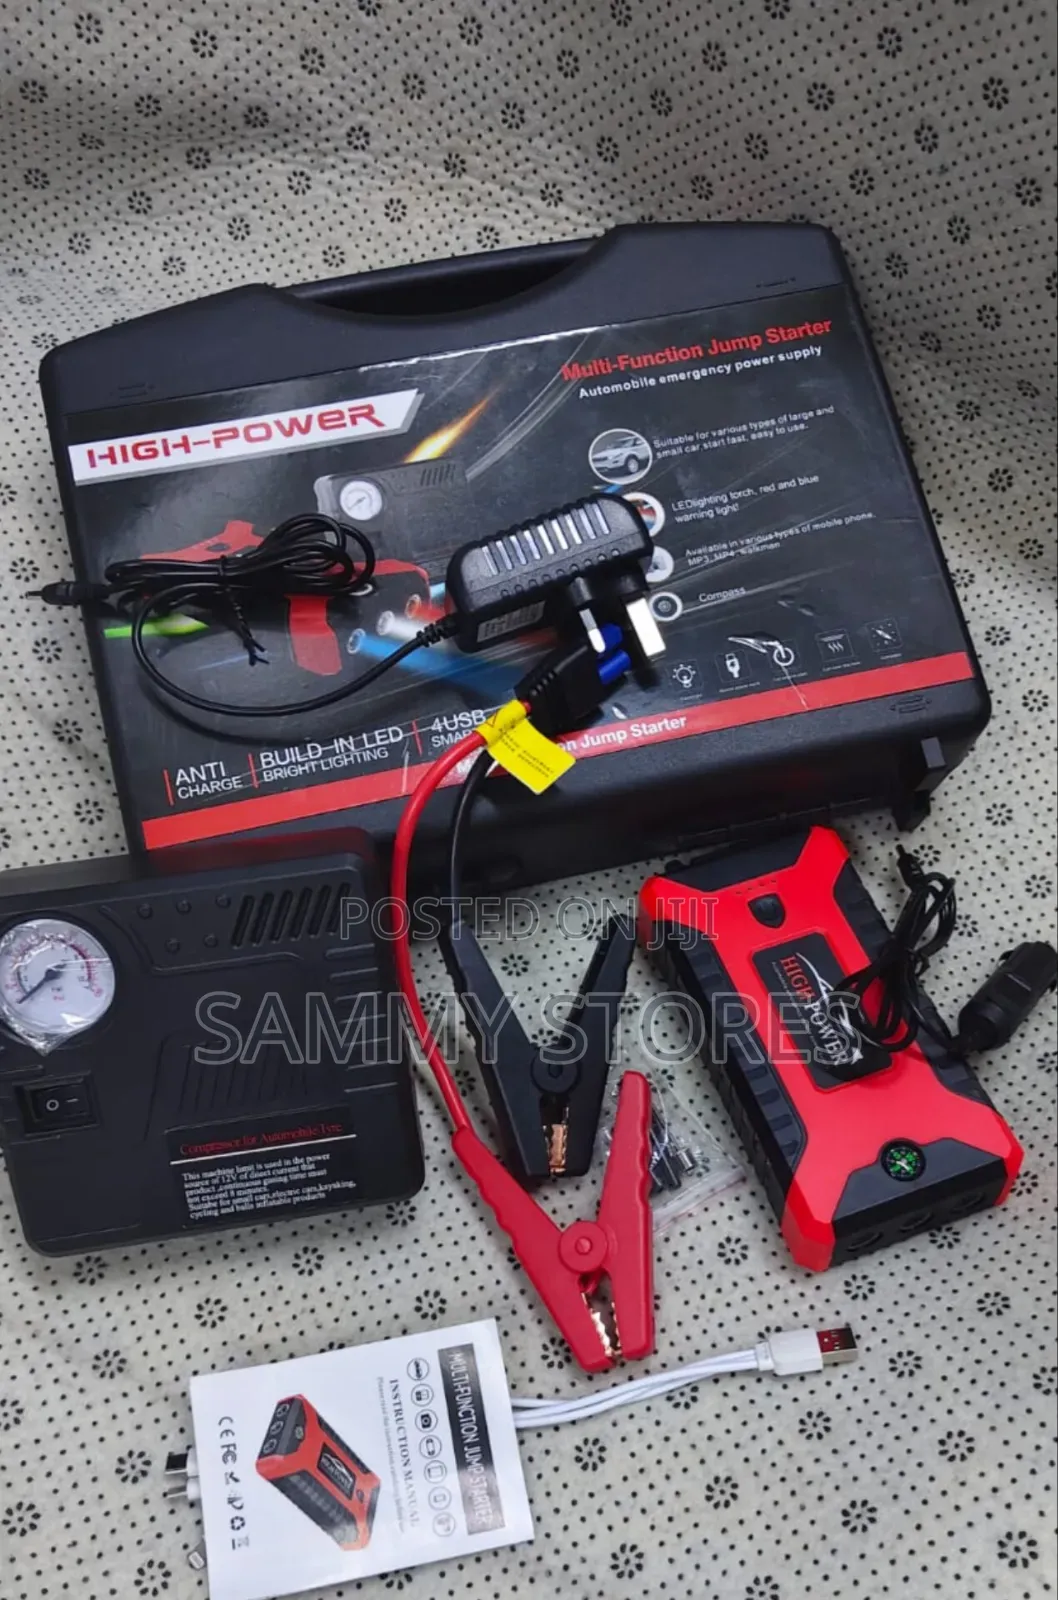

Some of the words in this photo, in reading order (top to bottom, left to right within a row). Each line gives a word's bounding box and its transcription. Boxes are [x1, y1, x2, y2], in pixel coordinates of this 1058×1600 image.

[561, 343, 704, 381] Multi-Function
[708, 334, 763, 356] Jump
[766, 319, 832, 344] Starter
[578, 377, 656, 399] Automobile
[659, 364, 732, 384] emergency
[735, 354, 776, 372] power
[778, 344, 822, 362] supply
[654, 434, 694, 448] Suitable
[696, 431, 709, 440] for
[711, 424, 748, 437] various
[749, 418, 776, 430] types
[778, 414, 788, 424] of
[788, 411, 814, 422] large
[816, 406, 834, 416] and
[656, 446, 683, 459] small
[750, 430, 773, 441] easy
[776, 426, 786, 434] to
[760, 483, 775, 494] red
[778, 478, 797, 490] and
[798, 474, 819, 486] blue
[675, 508, 714, 523] warning
[686, 541, 728, 557] Available
[729, 540, 738, 548] in
[801, 524, 811, 533] of
[812, 518, 842, 530] mobile
[699, 586, 746, 602] Compass
[431, 709, 486, 732] 4USB
[580, 730, 627, 748] Jump
[630, 716, 686, 737] Starter
[362, 726, 404, 749] LED
[175, 761, 226, 786] ANTI
[262, 760, 318, 782] BRIGHT
[319, 747, 389, 772] LIGHTING
[177, 776, 243, 798] CHARGE
[780, 956, 816, 1001] HIGH
[804, 1000, 849, 1066] POWER
[182, 1172, 200, 1181] This
[202, 1168, 235, 1178] machine
[256, 1162, 262, 1170] is
[264, 1160, 282, 1169] used
[284, 1158, 292, 1166] in
[292, 1156, 305, 1164] the
[306, 1153, 330, 1164] power
[221, 1174, 237, 1183] 12V
[239, 1172, 248, 1180] of
[220, 1204, 235, 1214] and
[447, 1351, 479, 1443] MULTI-FUNCTION
[388, 1379, 411, 1467] INSTRUCTION
[463, 1443, 484, 1474] JUMP
[468, 1475, 493, 1525] STARTER
